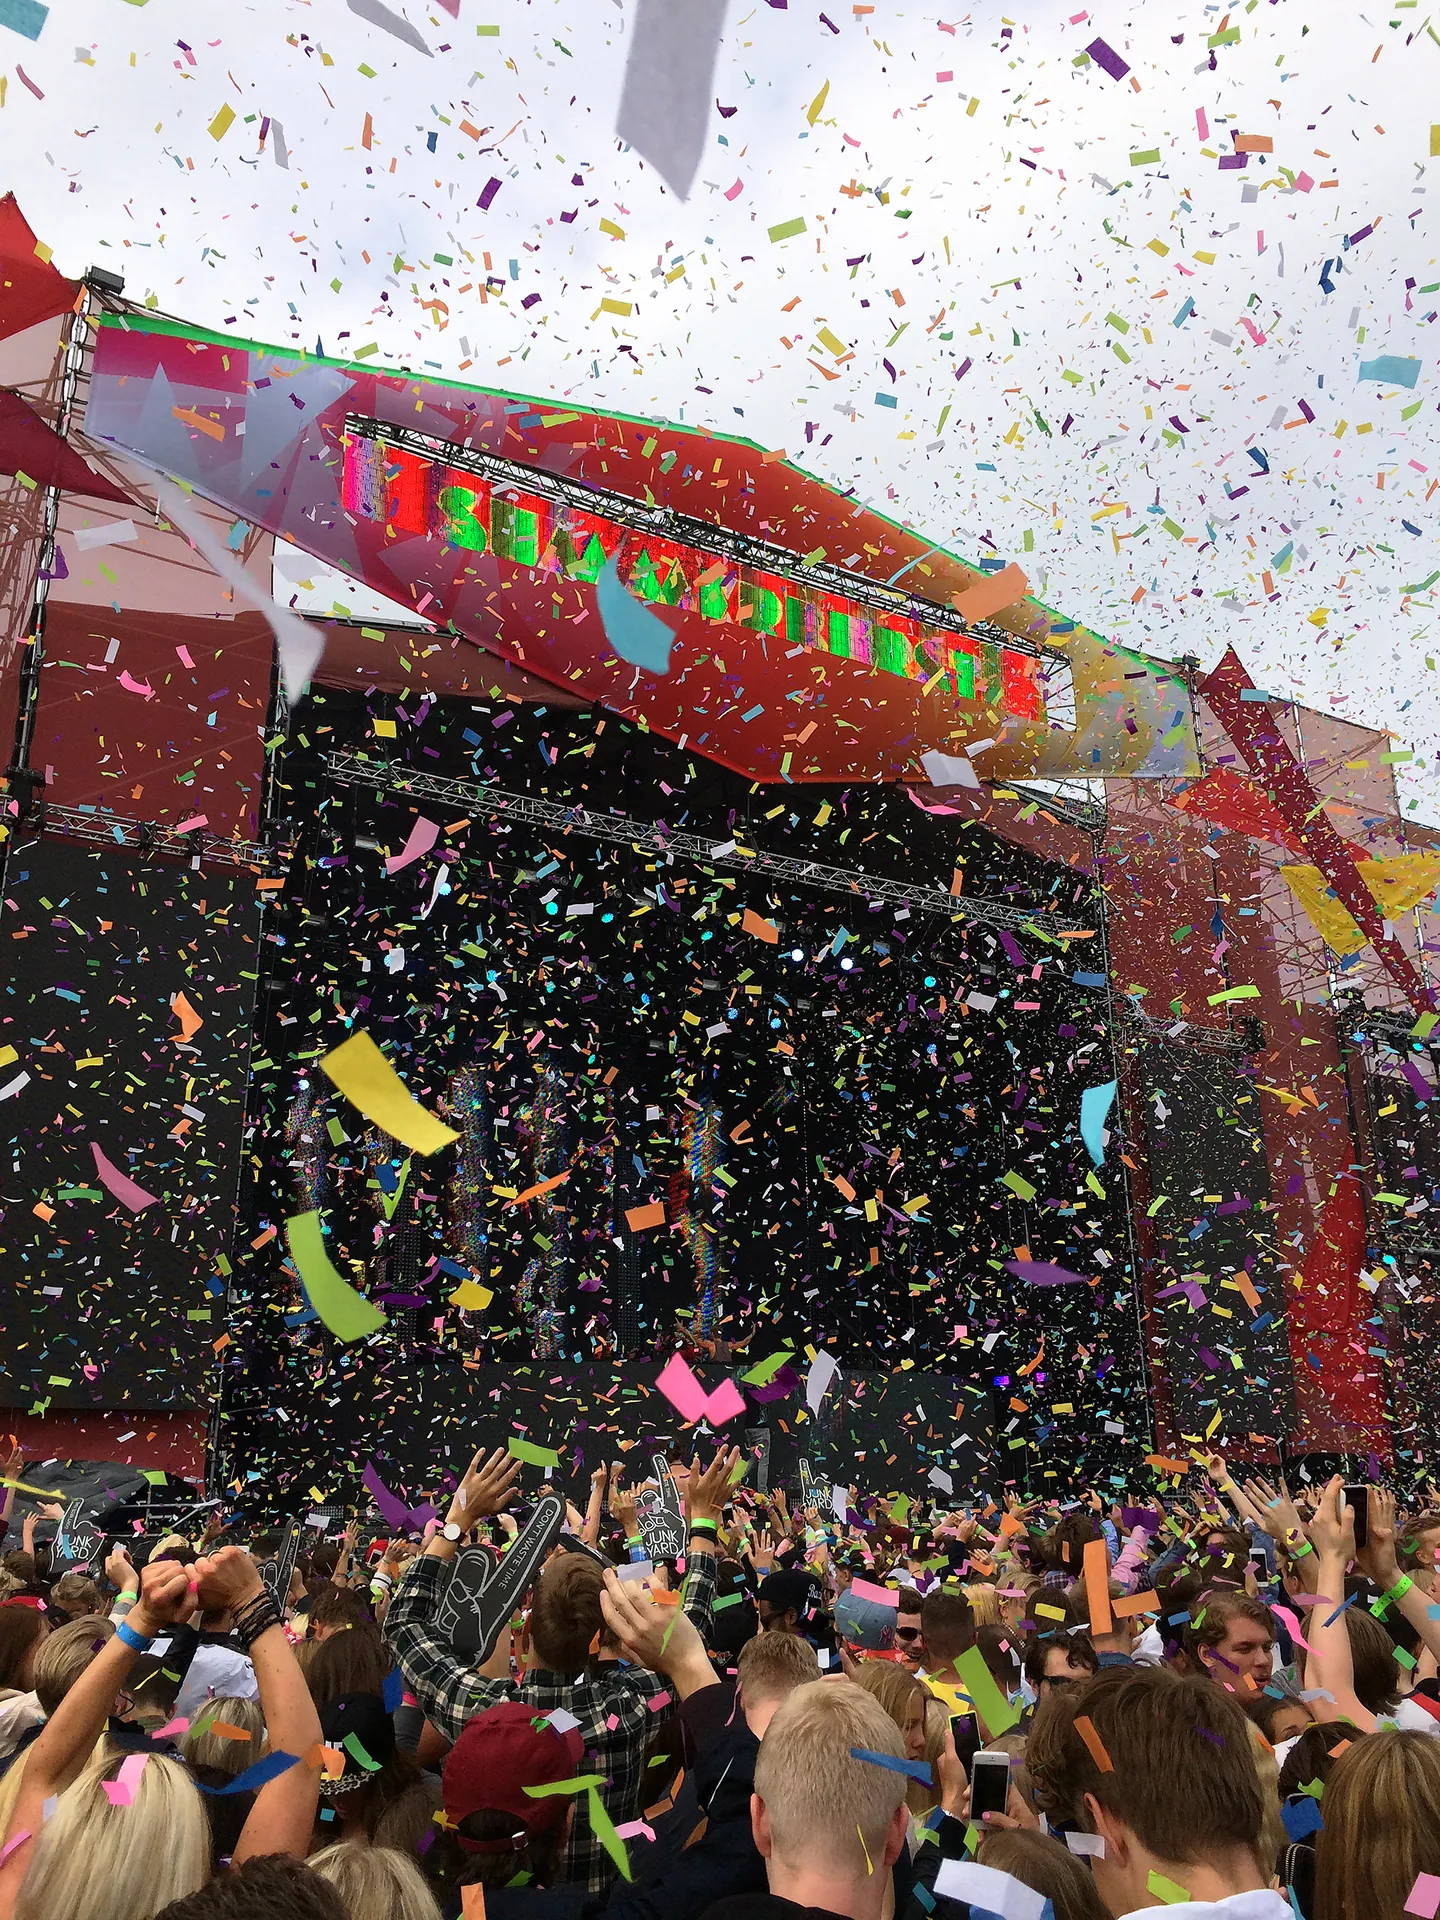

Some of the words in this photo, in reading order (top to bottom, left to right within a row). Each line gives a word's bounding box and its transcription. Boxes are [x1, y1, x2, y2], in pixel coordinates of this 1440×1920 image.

[645, 1529, 679, 1547] JUNK
[512, 1536, 536, 1567] WASTE
[498, 1567, 517, 1589] TIME
